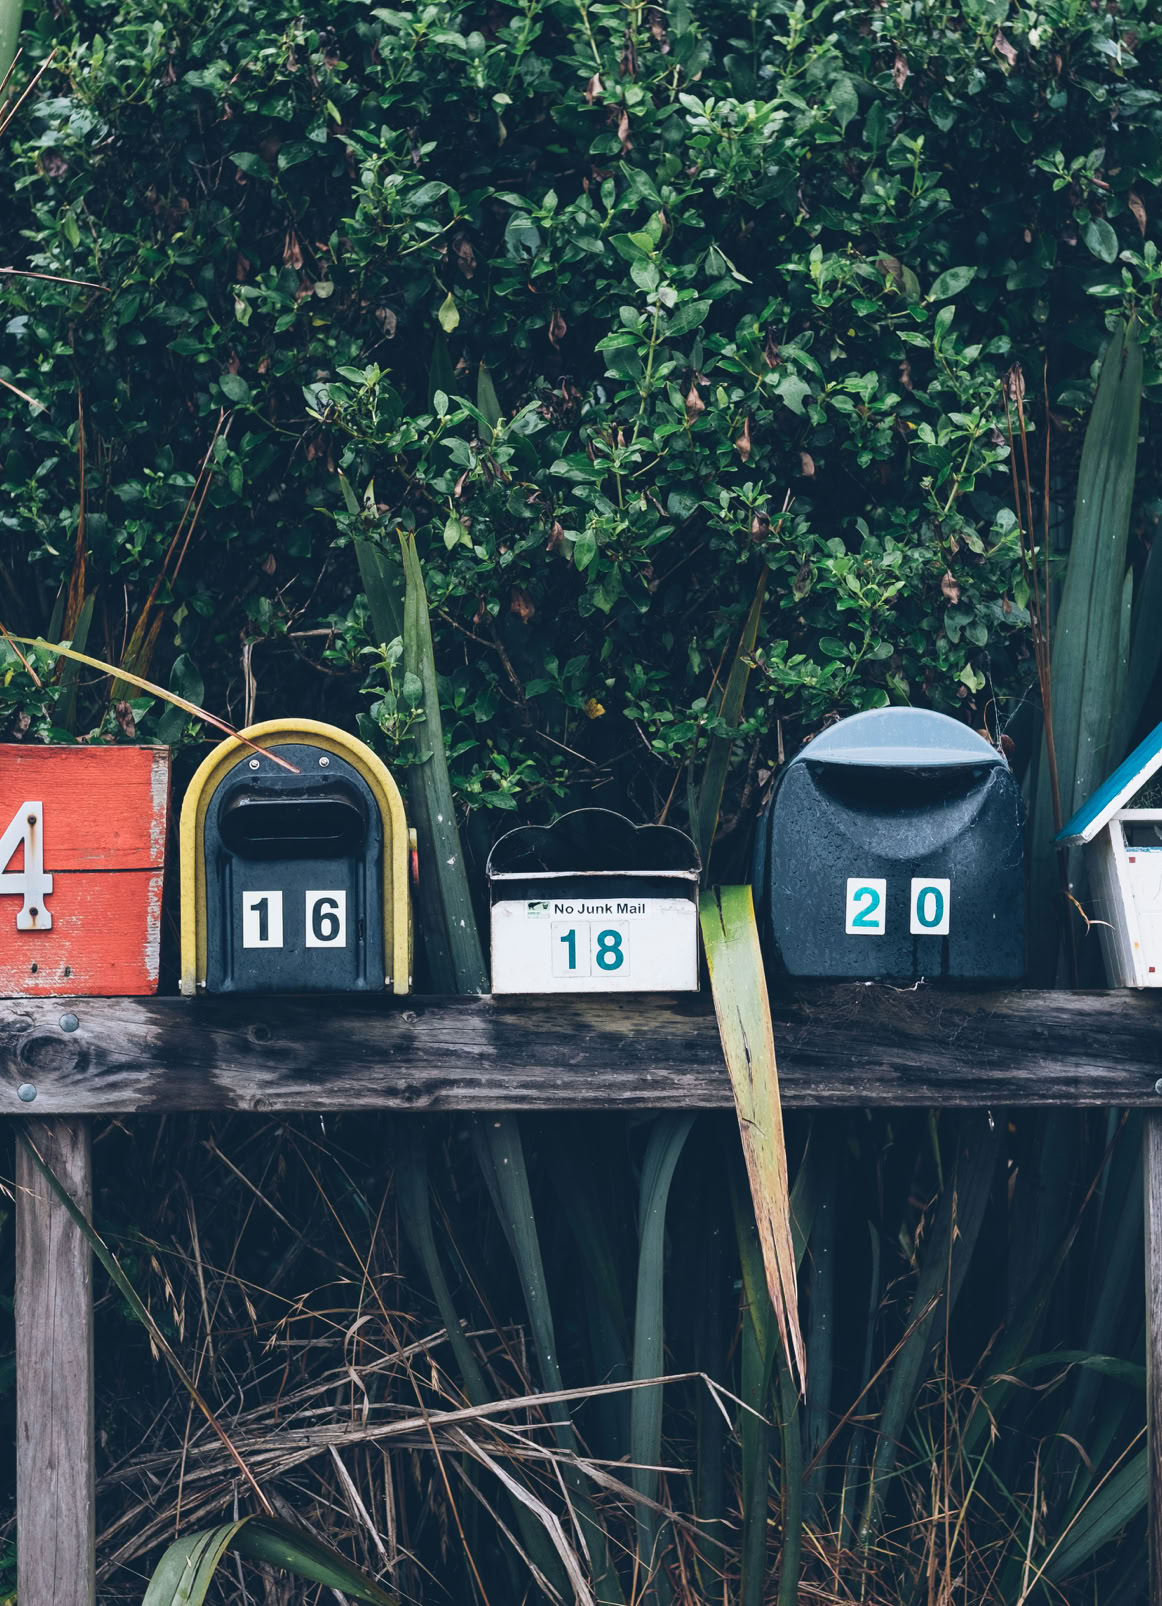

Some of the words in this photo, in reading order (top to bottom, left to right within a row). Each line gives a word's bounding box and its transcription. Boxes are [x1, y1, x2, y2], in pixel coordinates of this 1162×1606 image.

[0, 801, 53, 930] 4
[250, 897, 341, 941] 16
[553, 903, 574, 914] No
[577, 903, 613, 914] Junk
[616, 903, 646, 914] Mail
[851, 886, 944, 928] 20
[560, 929, 624, 971] 18
